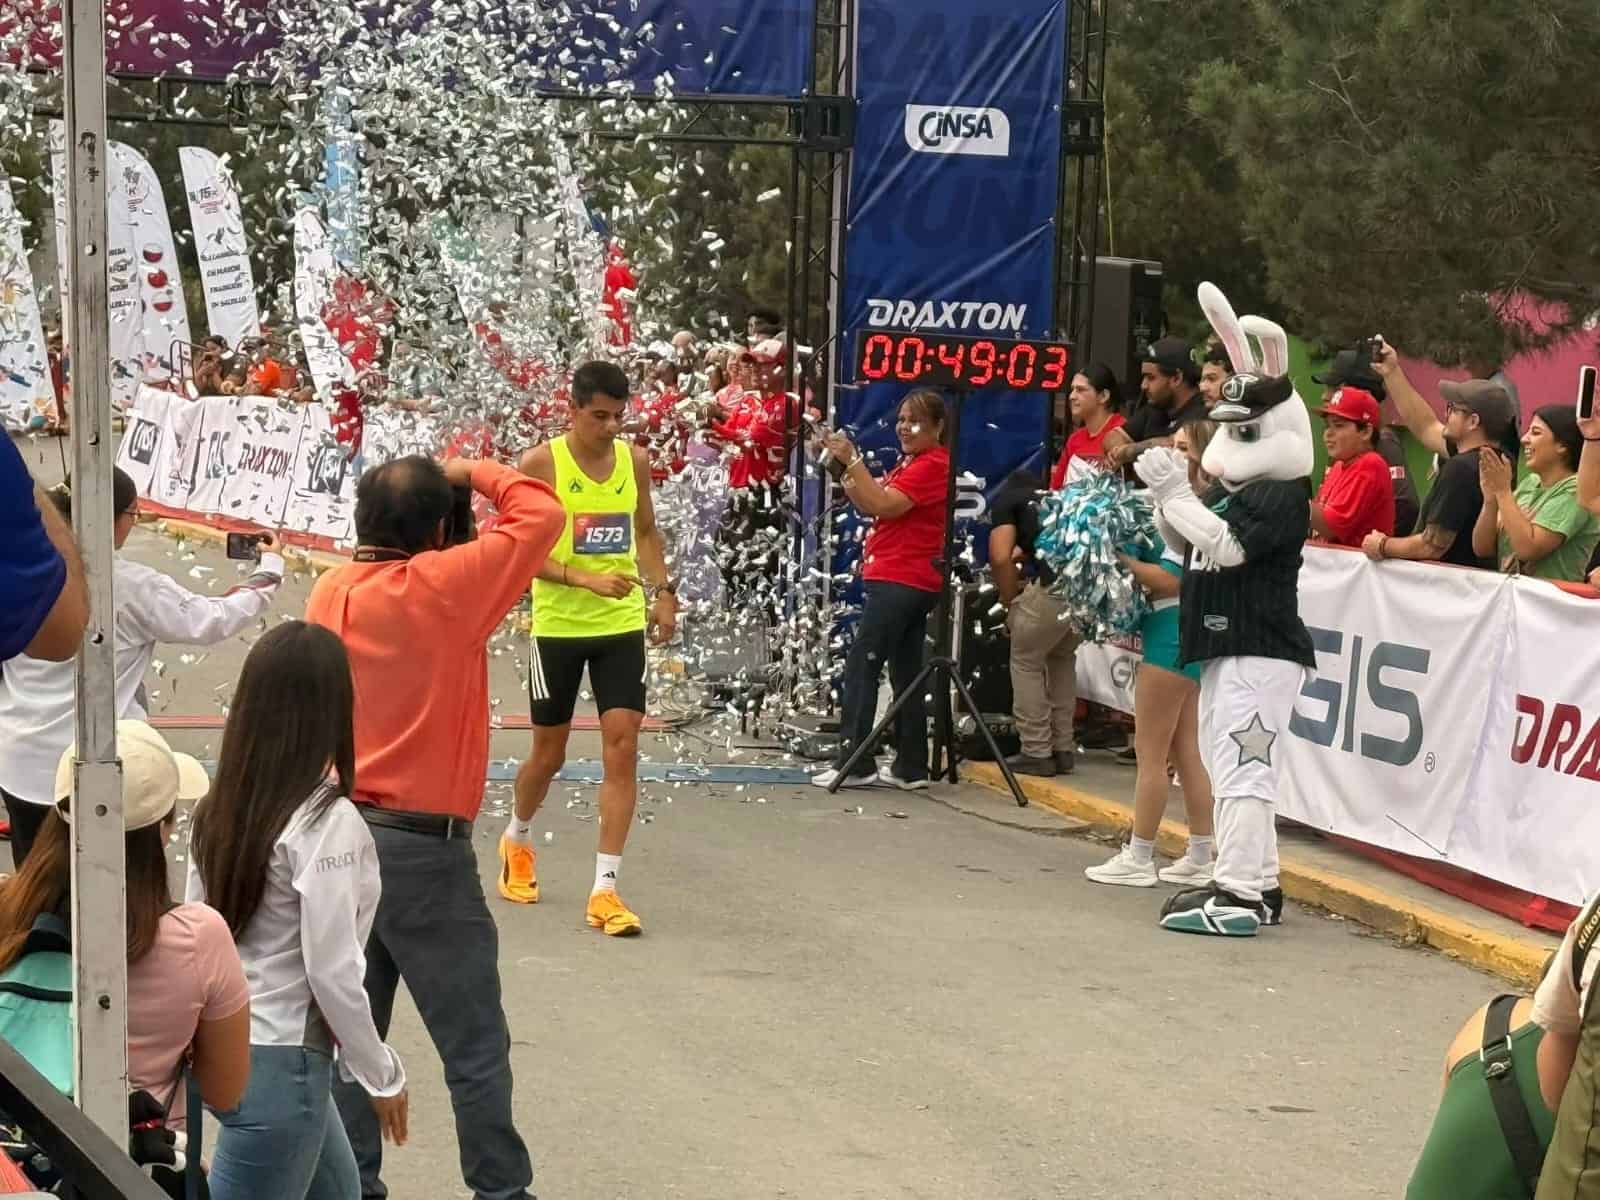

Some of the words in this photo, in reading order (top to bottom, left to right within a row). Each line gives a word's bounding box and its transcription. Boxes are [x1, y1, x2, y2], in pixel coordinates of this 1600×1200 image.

[867, 299, 1028, 331] DRAXTON
[862, 334, 1068, 389] 00:49:03
[585, 527, 624, 543] 1573
